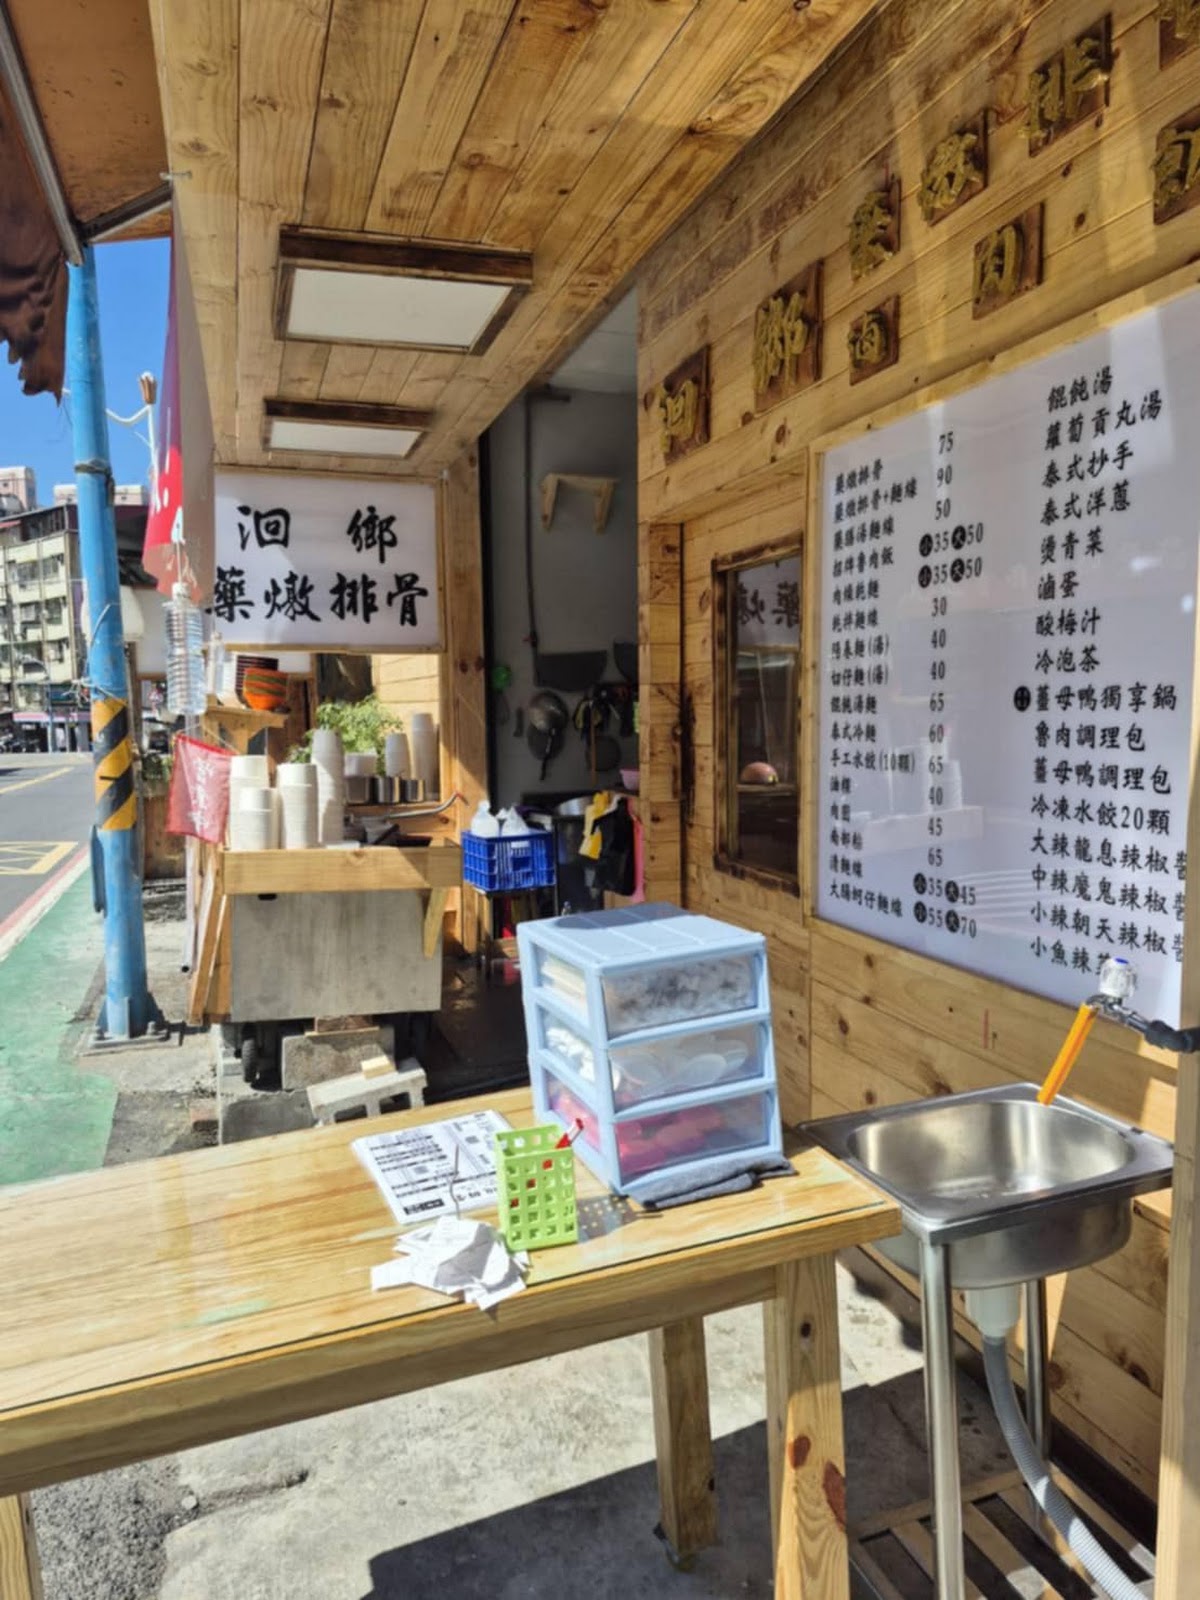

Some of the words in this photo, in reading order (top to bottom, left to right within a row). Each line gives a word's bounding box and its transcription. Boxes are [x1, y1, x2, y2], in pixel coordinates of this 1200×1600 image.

[1047, 364, 1114, 413] 餛飩湯
[939, 431, 954, 454] 75
[1041, 439, 1135, 488] 泰式抄手
[936, 465, 953, 488] 90
[935, 498, 951, 520] 50
[1040, 480, 1131, 526] 泰式洋蔥
[1040, 526, 1104, 566] 燙青菜
[205, 566, 429, 627] 藥燉排骨
[1037, 570, 1080, 601] 滷蛋
[931, 597, 947, 617] 30
[1035, 606, 1101, 638] 酸梅汁
[930, 628, 946, 649] 40
[930, 660, 946, 680] 40
[1035, 646, 1100, 674] 冷泡茶
[929, 692, 945, 712] 65
[928, 723, 944, 743] 60
[1035, 722, 1146, 752] 魯肉調理包
[928, 754, 944, 775] 65
[1033, 757, 1172, 795] 薑母鴨調理包
[928, 786, 944, 806] 40
[927, 816, 943, 836] 45
[927, 848, 943, 867] 65
